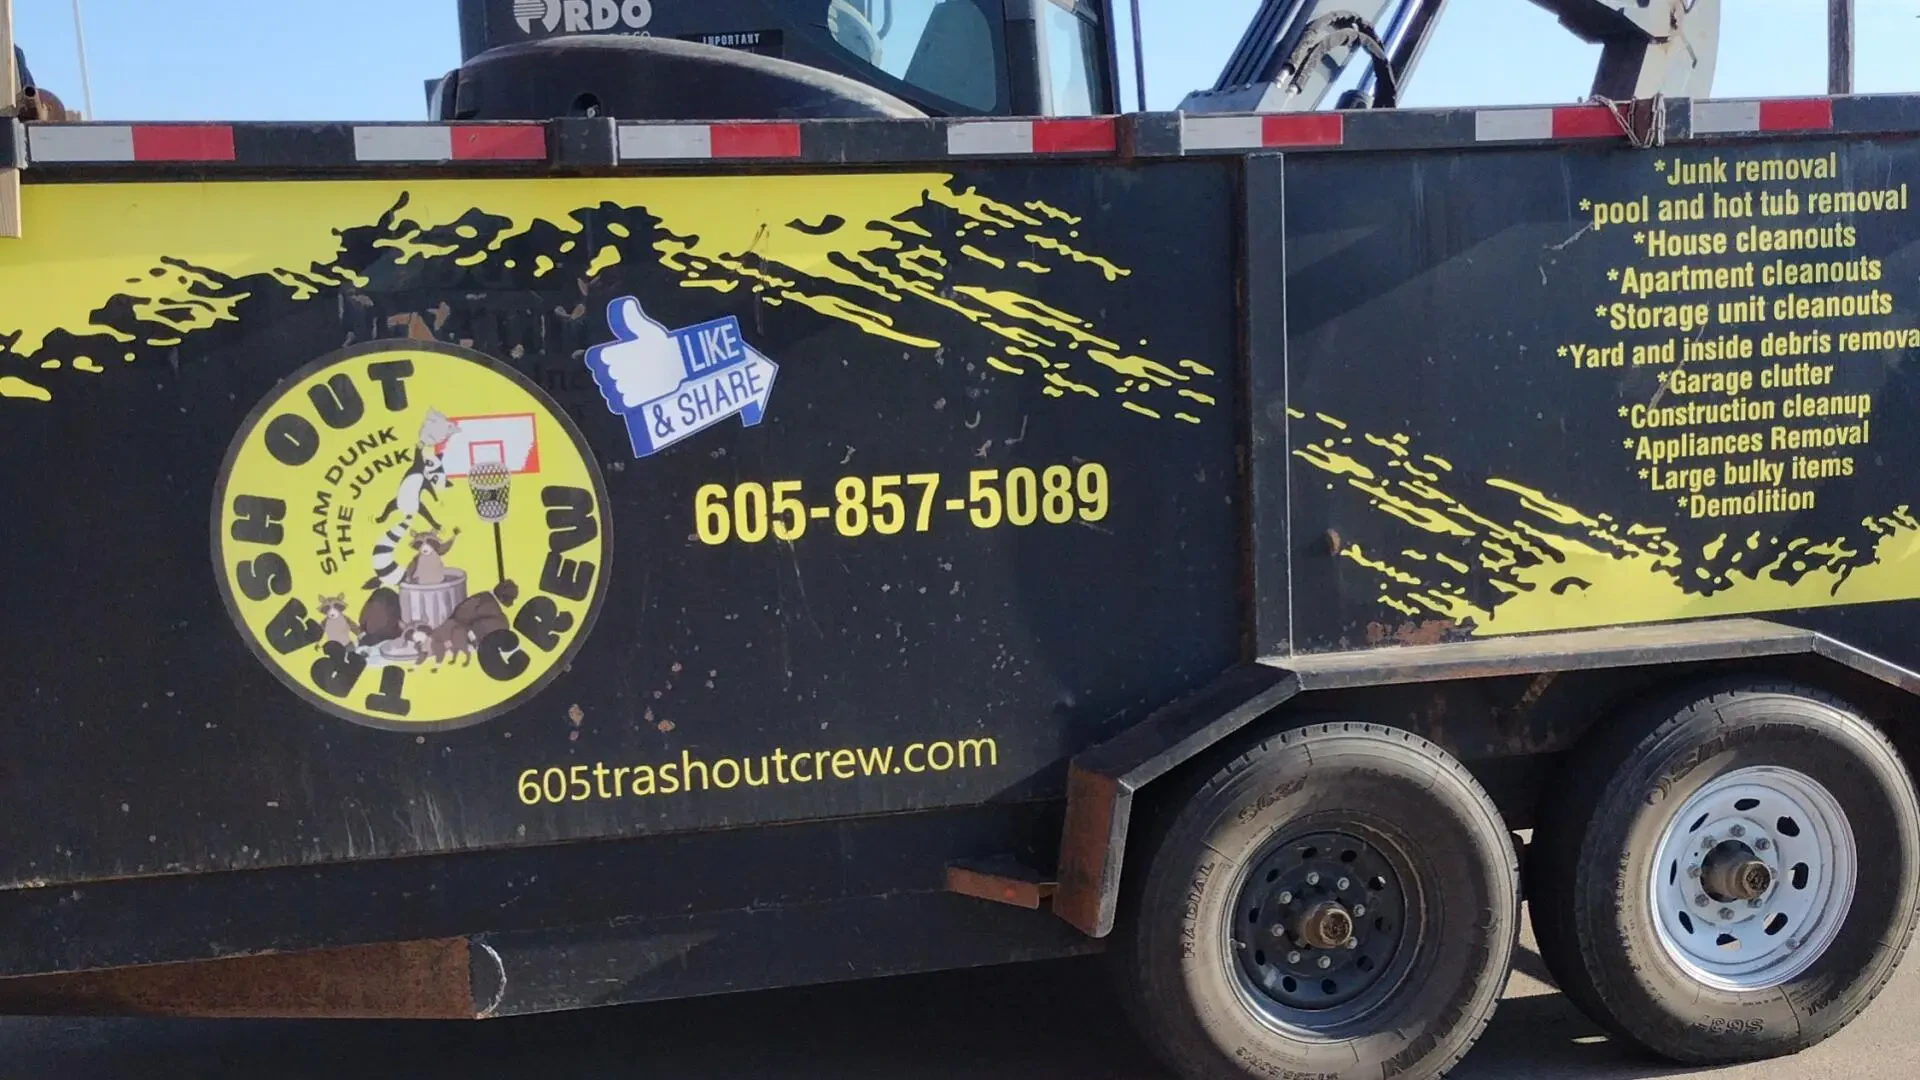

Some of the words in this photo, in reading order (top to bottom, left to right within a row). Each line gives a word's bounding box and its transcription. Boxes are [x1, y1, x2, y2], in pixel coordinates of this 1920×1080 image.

[563, 0, 652, 32] RDO
[703, 33, 760, 46] IMPORTANT
[1736, 152, 1837, 180] removal
[1659, 193, 1704, 221] and
[1714, 190, 1752, 218] hot
[1761, 189, 1799, 216] tub
[1808, 184, 1907, 212] removal
[1736, 225, 1855, 252] cleanouts
[1762, 257, 1881, 286] cleanouts
[1718, 296, 1765, 323] unit
[1774, 290, 1892, 319] cleanouts
[688, 328, 741, 371] LIKE
[1632, 339, 1674, 366] and
[1683, 336, 1752, 361] inside
[1761, 333, 1830, 357] debris
[1761, 364, 1833, 388] clutter
[264, 358, 415, 467] OUT
[652, 404, 676, 438] &
[678, 364, 765, 427] SHARE
[1783, 393, 1870, 418] cleanup
[1771, 420, 1868, 450] Removal
[324, 426, 398, 486] DUNK
[1724, 459, 1784, 486] bulky
[1792, 456, 1853, 479] items
[337, 505, 355, 562] THE
[350, 448, 413, 500] JUNK
[695, 463, 1108, 545] 605-857-5089
[312, 490, 339, 576] SLAM
[477, 484, 599, 682] CREW
[231, 493, 411, 717] TRASH
[518, 738, 996, 804] 605trashoutcrew.com
[1183, 862, 1216, 958] RADIAL
